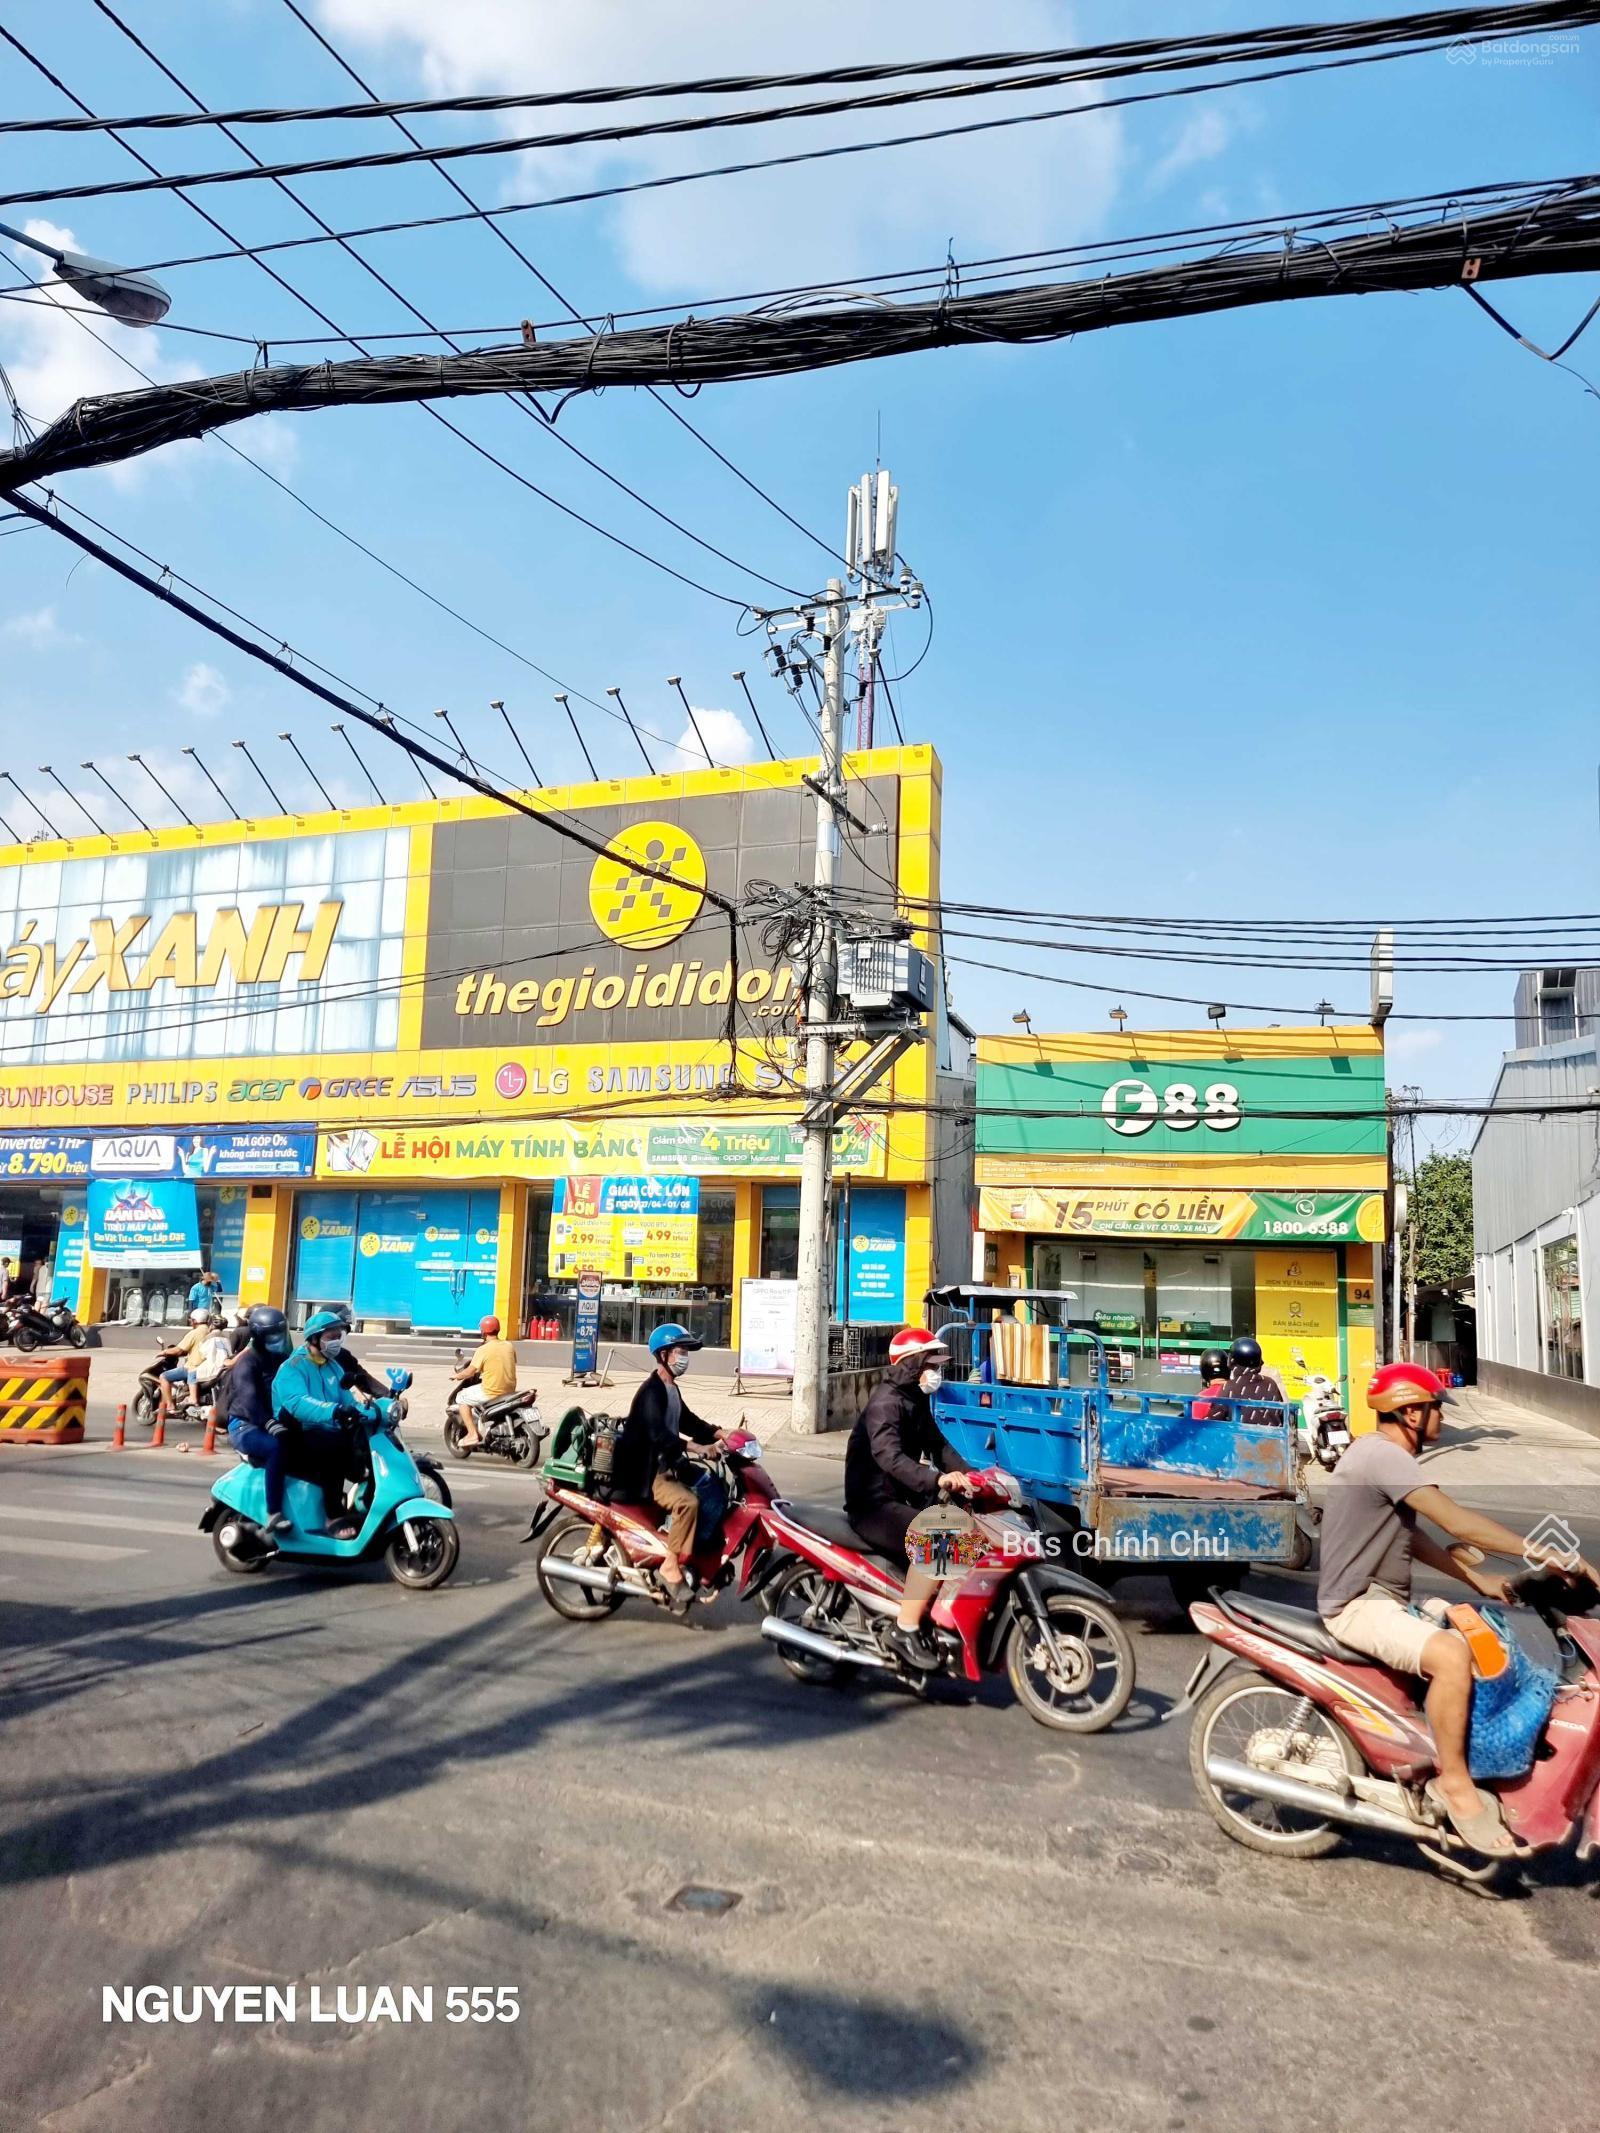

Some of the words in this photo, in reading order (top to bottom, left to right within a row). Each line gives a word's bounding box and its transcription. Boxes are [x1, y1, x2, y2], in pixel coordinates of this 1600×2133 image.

[127, 1082, 218, 1105] PHILIPS
[227, 1079, 295, 1102] acer
[324, 1077, 393, 1097] GREE
[397, 1074, 476, 1098] ASUS
[532, 1067, 569, 1095] LG
[587, 1063, 735, 1092] SAMSUNG
[1101, 1079, 1241, 1132] F88
[251, 1135, 271, 1147] GÓP
[272, 1134, 287, 1147] 0%
[723, 1133, 770, 1154] Triệu
[102, 1139, 161, 1158] AQUA
[220, 1149, 245, 1160] không
[275, 1148, 298, 1158] trước
[381, 1133, 405, 1159] LỄ
[412, 1135, 450, 1164] HỘI
[456, 1134, 504, 1159] MÁY
[511, 1134, 564, 1158] TÍNH
[7, 1152, 67, 1175] 8.790
[652, 1154, 687, 1162] SAMSUNG
[606, 1198, 614, 1211] 5
[1096, 1199, 1129, 1211] PHÚT
[1134, 1198, 1170, 1220] CÓ
[1177, 1195, 1224, 1220] LIỀN
[1055, 1200, 1094, 1230] 15
[320, 1226, 352, 1235] XANH
[1184, 1224, 1194, 1232] XE
[1264, 1221, 1302, 1235] 1800
[1308, 1221, 1349, 1235] 6388
[571, 1233, 594, 1244] 2.99
[647, 1230, 671, 1241] 4.99
[381, 1242, 415, 1253] XANH
[647, 1266, 671, 1277] 5.99
[1354, 1289, 1371, 1300] 94
[582, 1302, 596, 1310] AQUA
[1112, 1313, 1136, 1321] nhanh
[1549, 1719, 1587, 1732] ONDA
